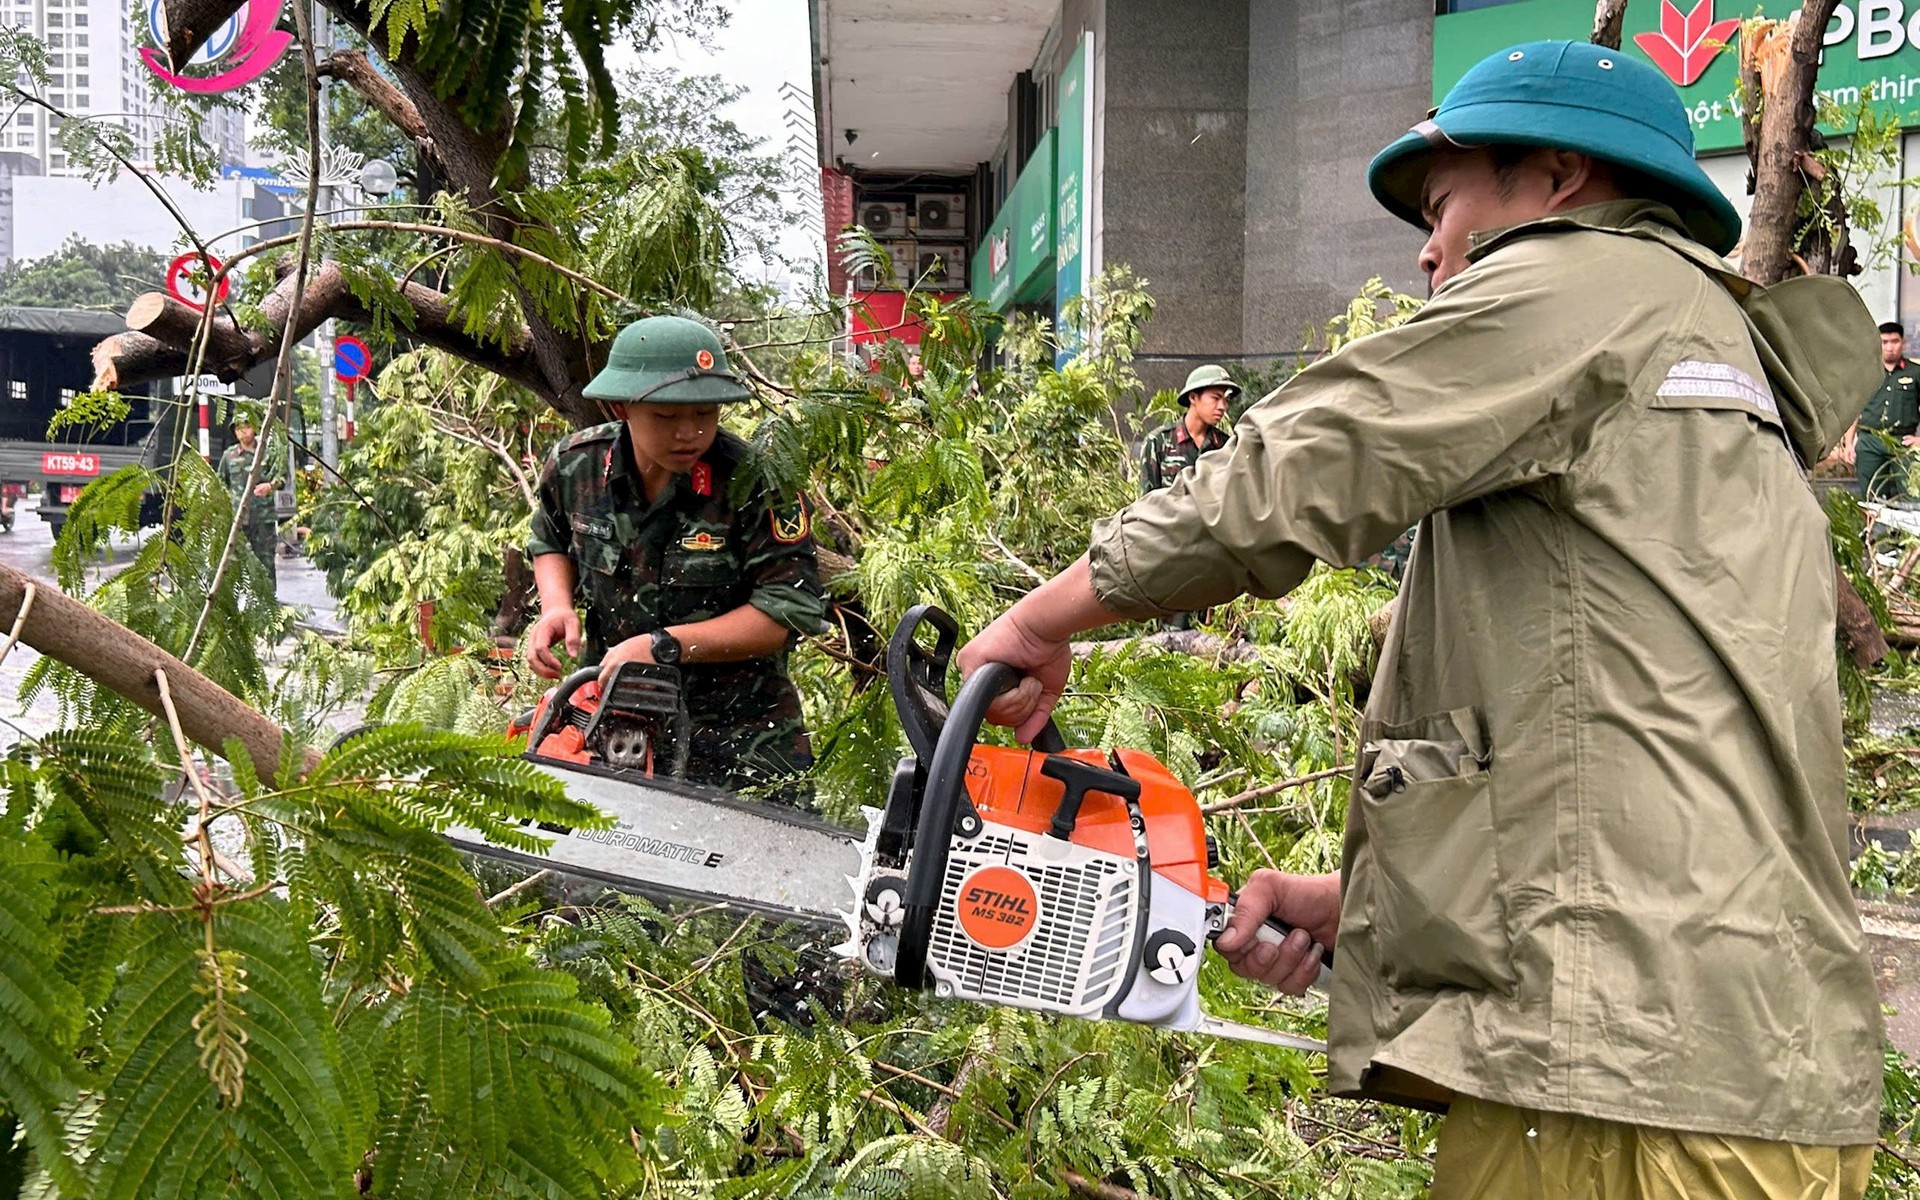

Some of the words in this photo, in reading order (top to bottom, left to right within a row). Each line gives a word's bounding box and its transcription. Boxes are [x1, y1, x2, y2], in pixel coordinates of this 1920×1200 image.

[576, 828, 706, 865] DUROMATIC
[703, 852, 725, 869] E
[965, 887, 1030, 915] STIHL
[971, 906, 996, 920] MS
[996, 912, 1025, 927] 382
